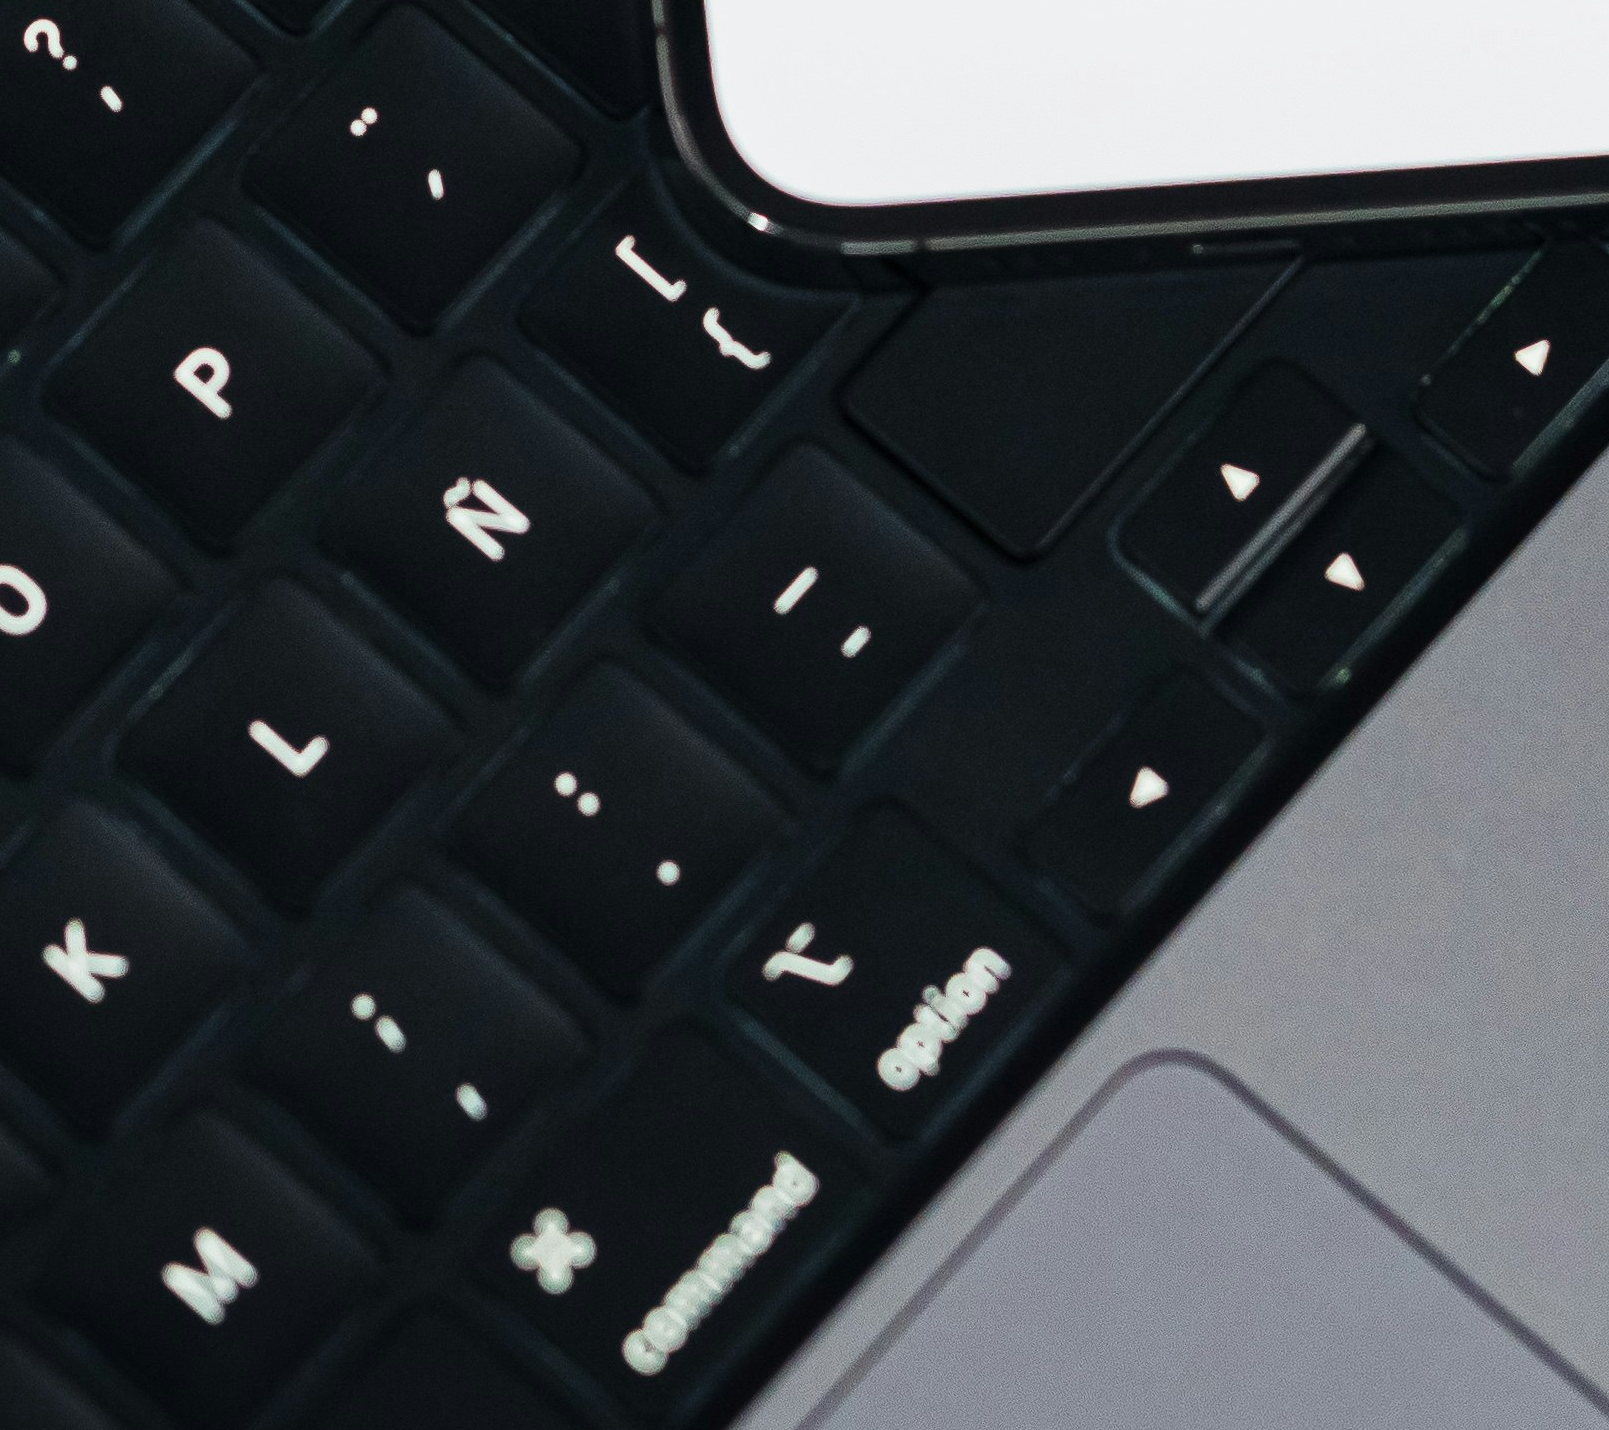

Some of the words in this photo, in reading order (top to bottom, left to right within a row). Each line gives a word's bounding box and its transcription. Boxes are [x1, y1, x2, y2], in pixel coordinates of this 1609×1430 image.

[171, 345, 234, 421] P
[432, 475, 533, 563] Ñ
[246, 718, 331, 779] L
[40, 917, 131, 1005] K
[875, 945, 1013, 1093] option
[160, 1226, 260, 1325] M
